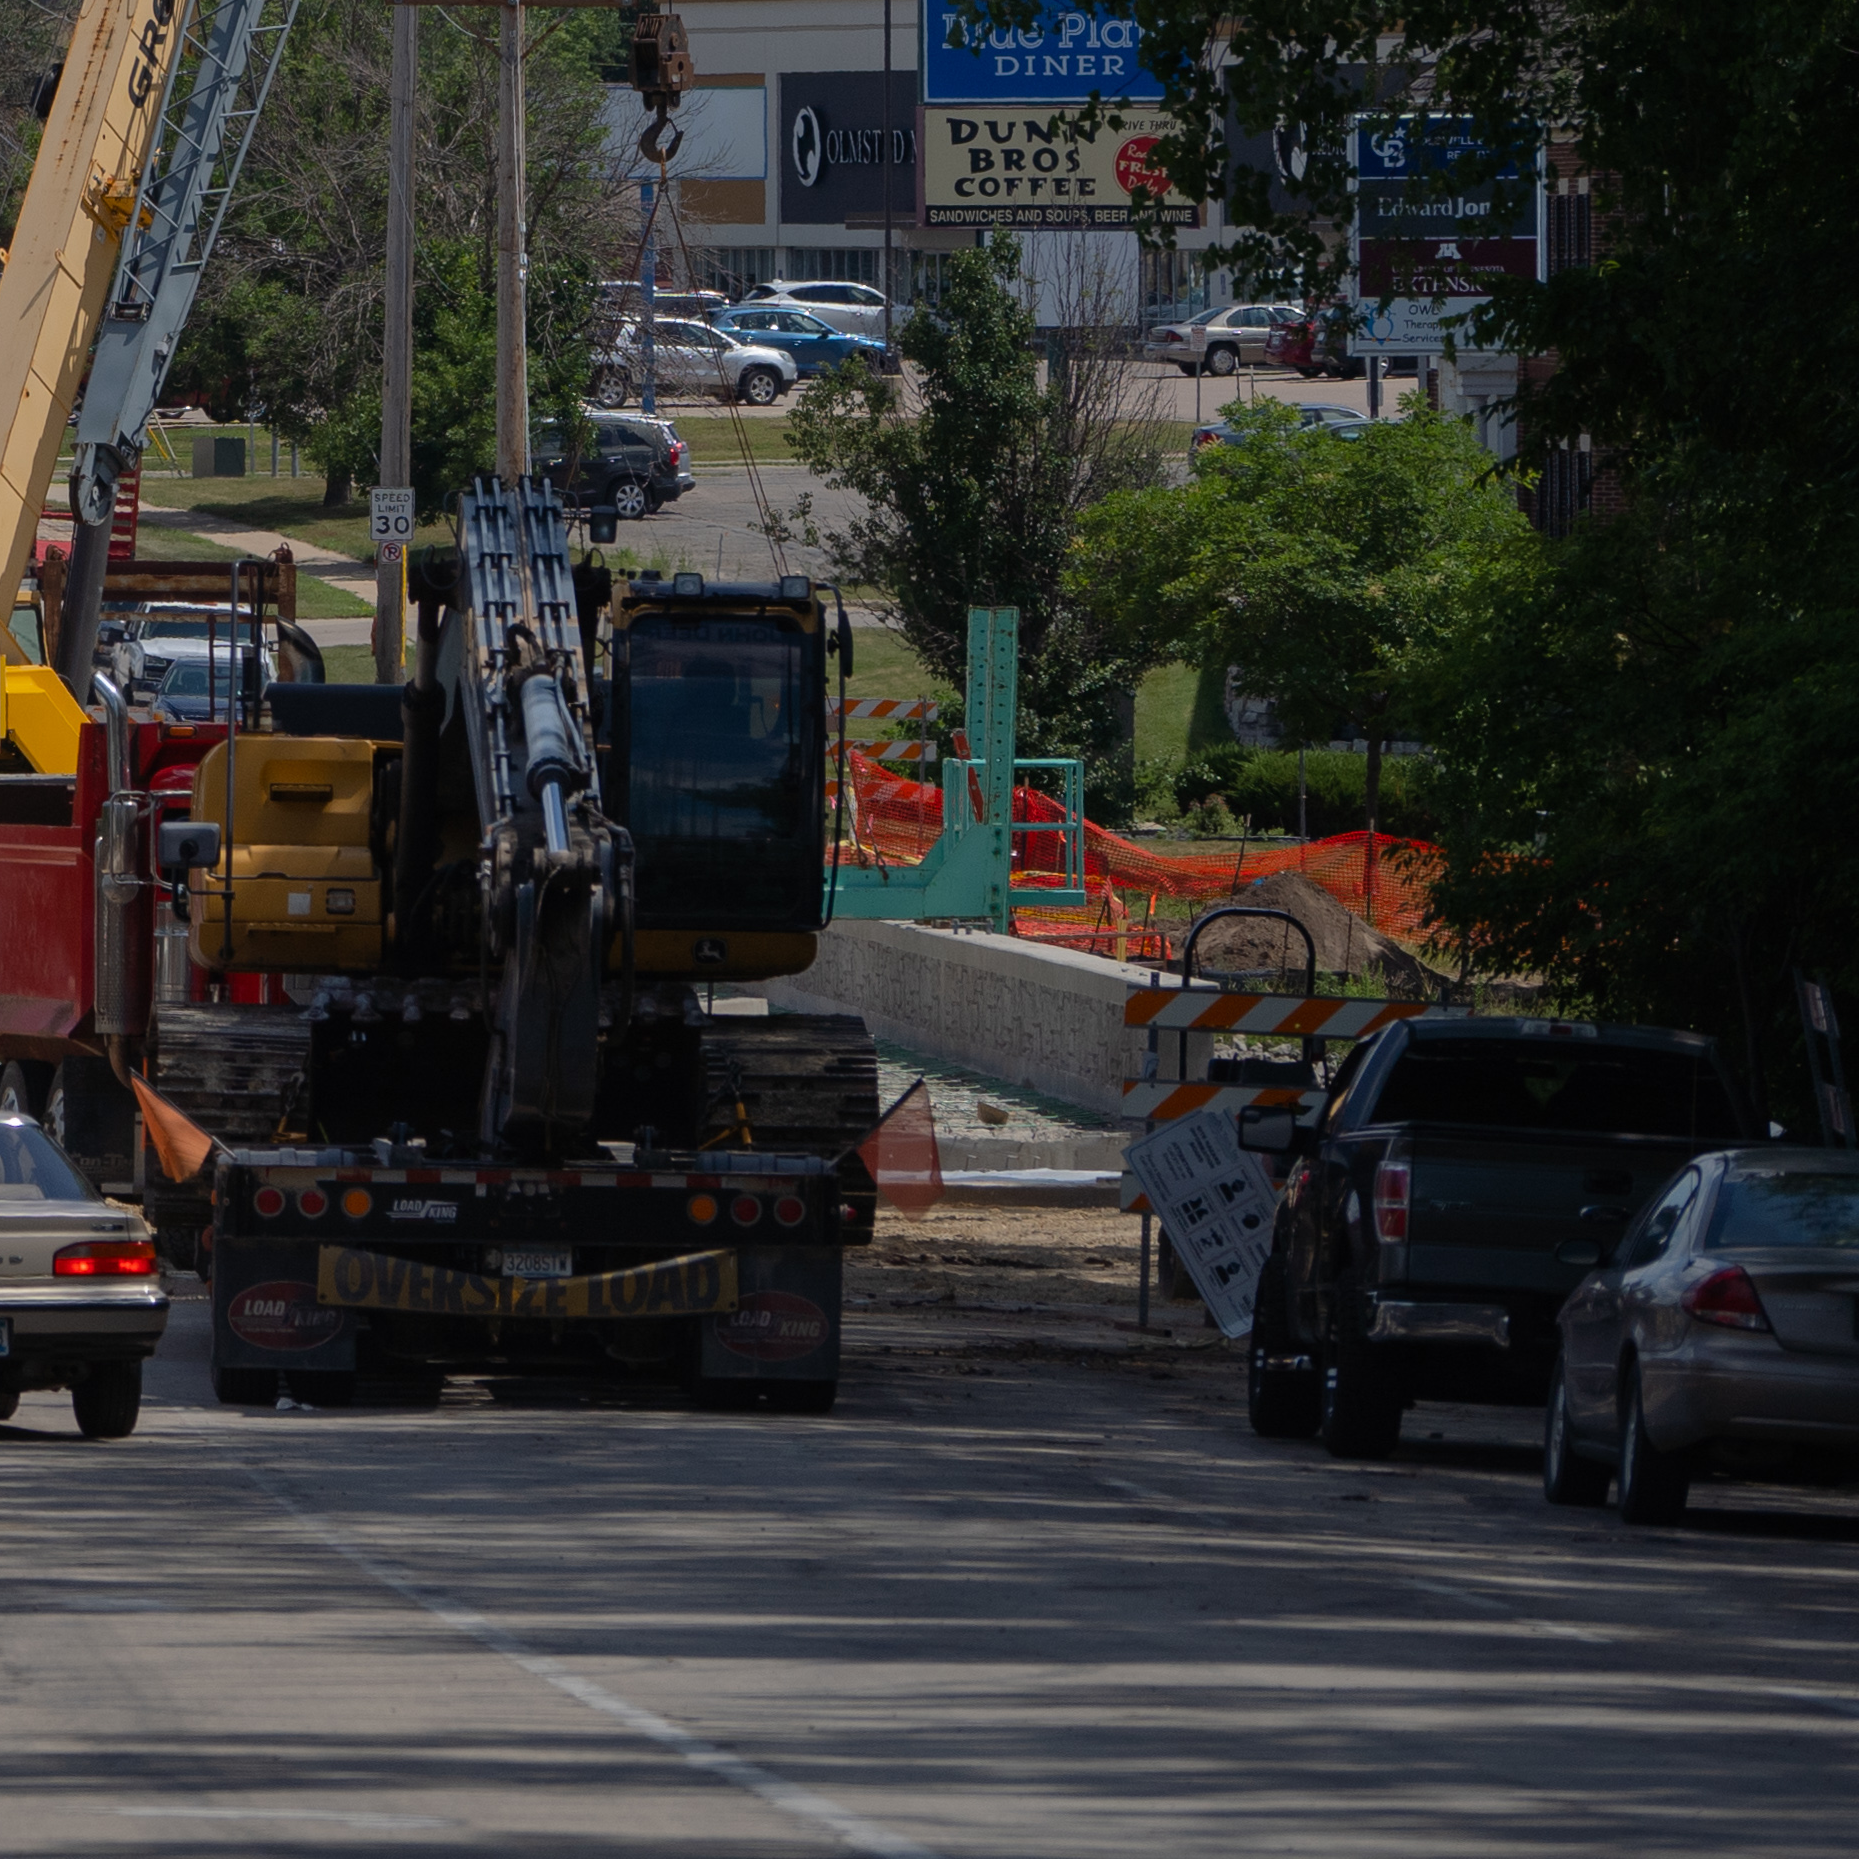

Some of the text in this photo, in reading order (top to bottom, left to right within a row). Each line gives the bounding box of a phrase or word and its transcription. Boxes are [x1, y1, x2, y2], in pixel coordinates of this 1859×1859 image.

[994, 55, 1125, 77] DINER
[1122, 120, 1177, 131] RIVE THRU
[826, 129, 905, 164] OLMSTD
[968, 147, 1080, 174] BROS
[954, 177, 1096, 198] COFFEE
[930, 209, 1014, 223] SANDWICHES
[1017, 209, 1043, 223] AND
[1095, 209, 1128, 223] BEER
[1161, 208, 1193, 223] WINE
[374, 493, 411, 503] SPEED
[377, 504, 406, 513] LIMIT
[375, 515, 410, 535] 30
[392, 1199, 457, 1220] LOAD KING
[333, 1248, 721, 1316] OVERSIZE LOAD
[243, 1298, 286, 1317] LOAD
[729, 1309, 821, 1338] LOAD KING
